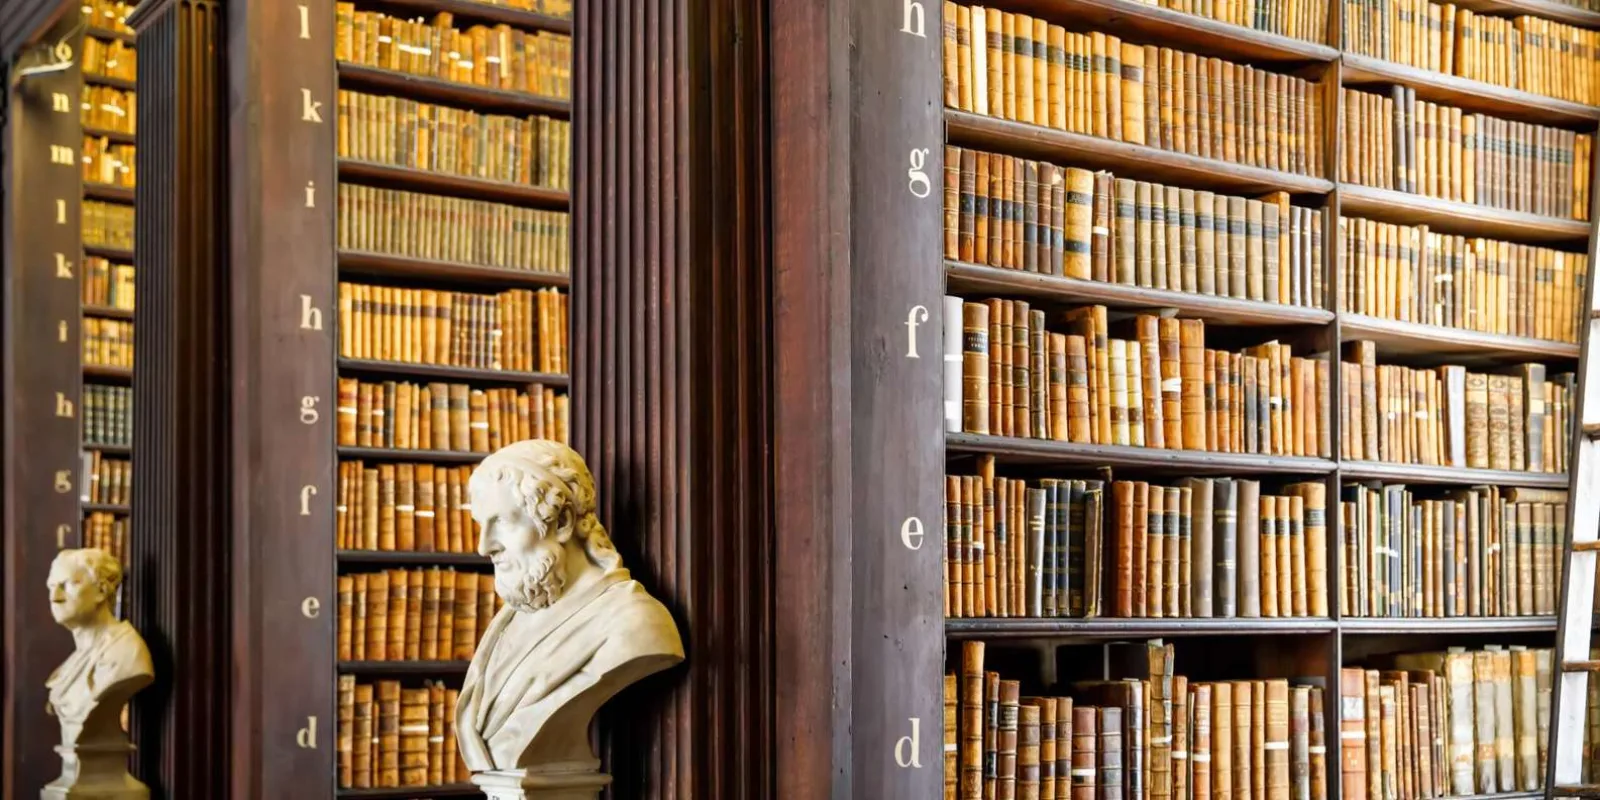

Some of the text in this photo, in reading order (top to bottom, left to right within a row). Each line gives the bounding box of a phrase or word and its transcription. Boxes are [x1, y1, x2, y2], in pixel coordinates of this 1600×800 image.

[298, 4, 311, 39] l
[900, 0, 927, 38] h
[52, 92, 70, 112] n
[301, 88, 322, 122] k
[51, 145, 74, 165] m
[908, 148, 931, 198] g
[305, 181, 315, 207] i
[57, 199, 67, 224] l
[56, 253, 73, 278] k
[300, 295, 322, 330] h
[58, 319, 68, 342] i
[904, 305, 929, 358] f
[55, 392, 73, 417] h
[300, 395, 320, 424] g
[54, 470, 72, 493] g
[300, 485, 317, 515] f
[56, 524, 71, 548] f
[901, 516, 924, 550] e
[301, 596, 320, 618] e
[297, 716, 317, 748] d
[895, 717, 922, 768] d
